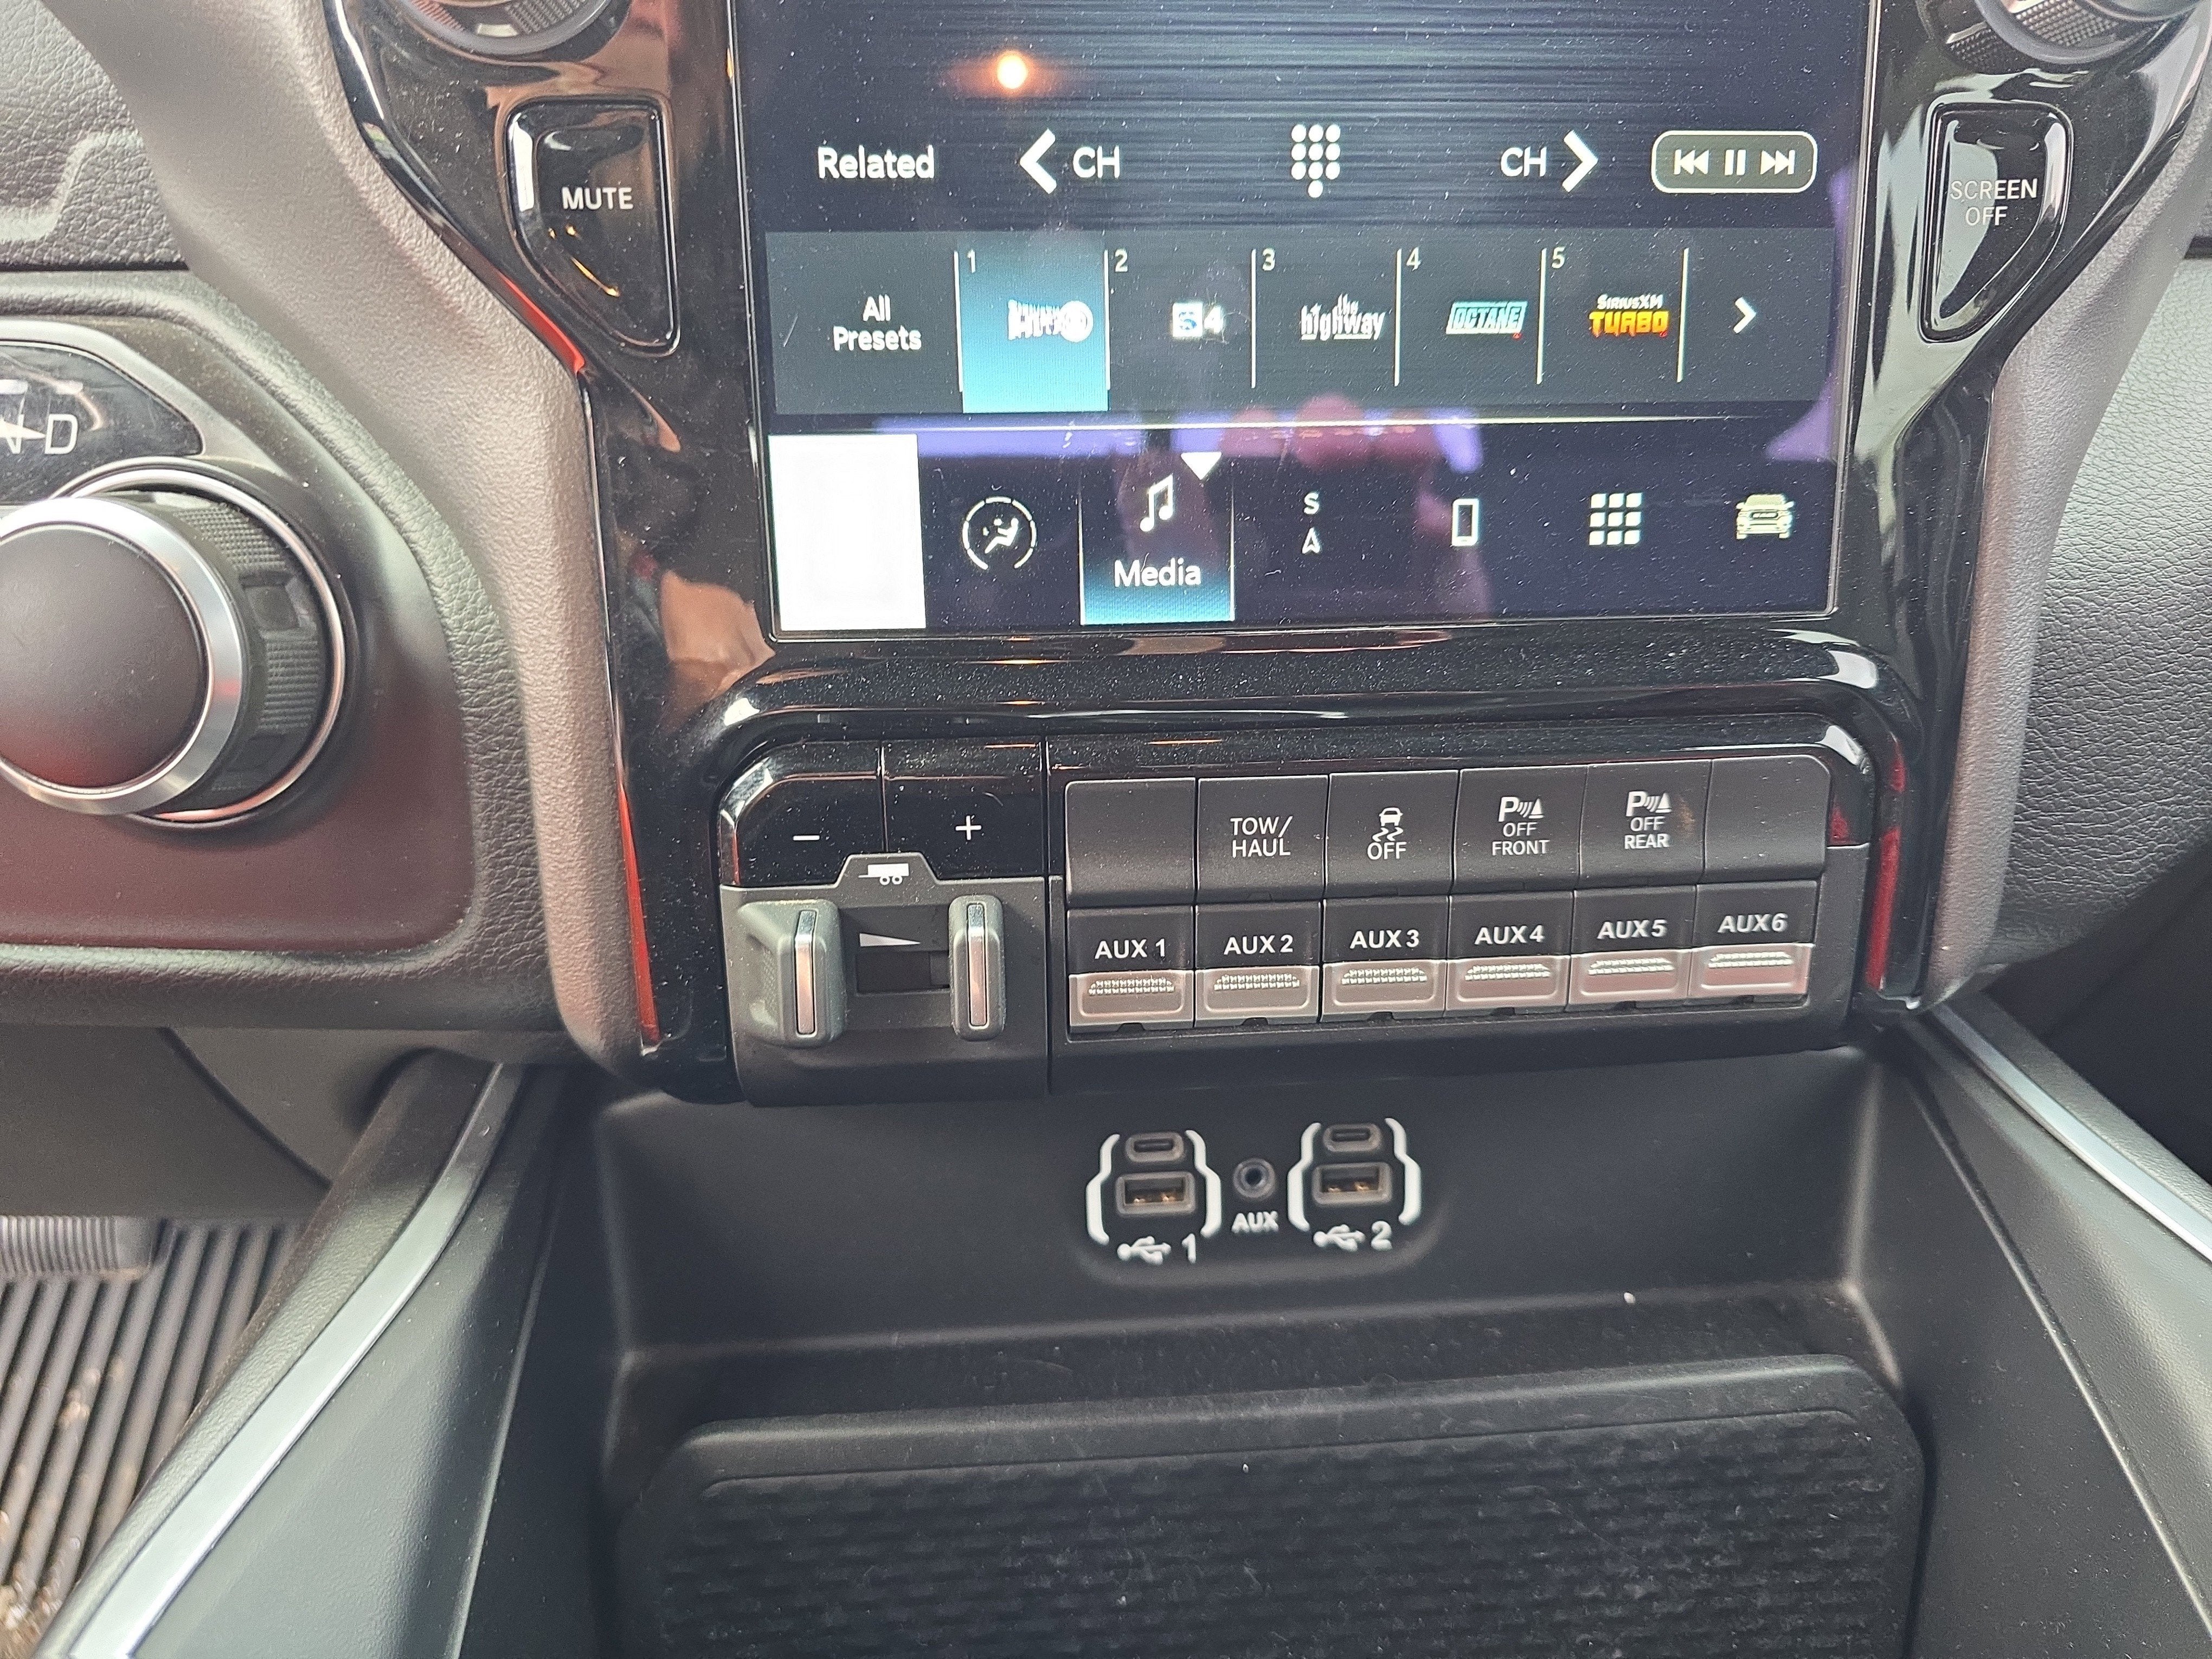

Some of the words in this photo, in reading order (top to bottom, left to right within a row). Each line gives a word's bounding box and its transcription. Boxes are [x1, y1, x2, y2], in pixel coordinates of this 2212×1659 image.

[818, 144, 935, 179] Related
[1072, 145, 1121, 179] CH
[1500, 146, 1547, 177] CH
[562, 187, 634, 210] MUTE
[1950, 178, 2038, 201] SCREEN
[1965, 205, 2008, 226] OFF
[967, 249, 976, 273] 1
[1115, 247, 1128, 272] 2
[1262, 248, 1276, 271] 3
[1406, 247, 1421, 271] 4
[1551, 246, 1565, 269] 5
[863, 294, 891, 321] All
[1452, 307, 1521, 329] OCTANE
[1589, 310, 1669, 337] TURBO
[833, 326, 922, 351] Presets
[44, 413, 79, 454] D
[1303, 492, 1320, 515] S
[1114, 557, 1201, 588] Media
[1230, 816, 1294, 838] TOW/
[1503, 822, 1538, 837] OFF
[1630, 816, 1666, 832] OFF
[1232, 838, 1291, 859] HAUL
[1367, 841, 1407, 860] OFF
[1492, 839, 1550, 856] FRONT
[1624, 833, 1669, 850] REAR
[1095, 939, 1148, 959] AUX
[1155, 938, 1165, 957] 1
[1223, 935, 1276, 955] AUX
[1280, 934, 1293, 953] 2
[1349, 930, 1402, 949] AUX
[1406, 929, 1419, 948] 3
[1231, 1211, 1279, 1233] AUX
[1371, 1220, 1392, 1250] 2
[1181, 1233, 1197, 1263] 1
